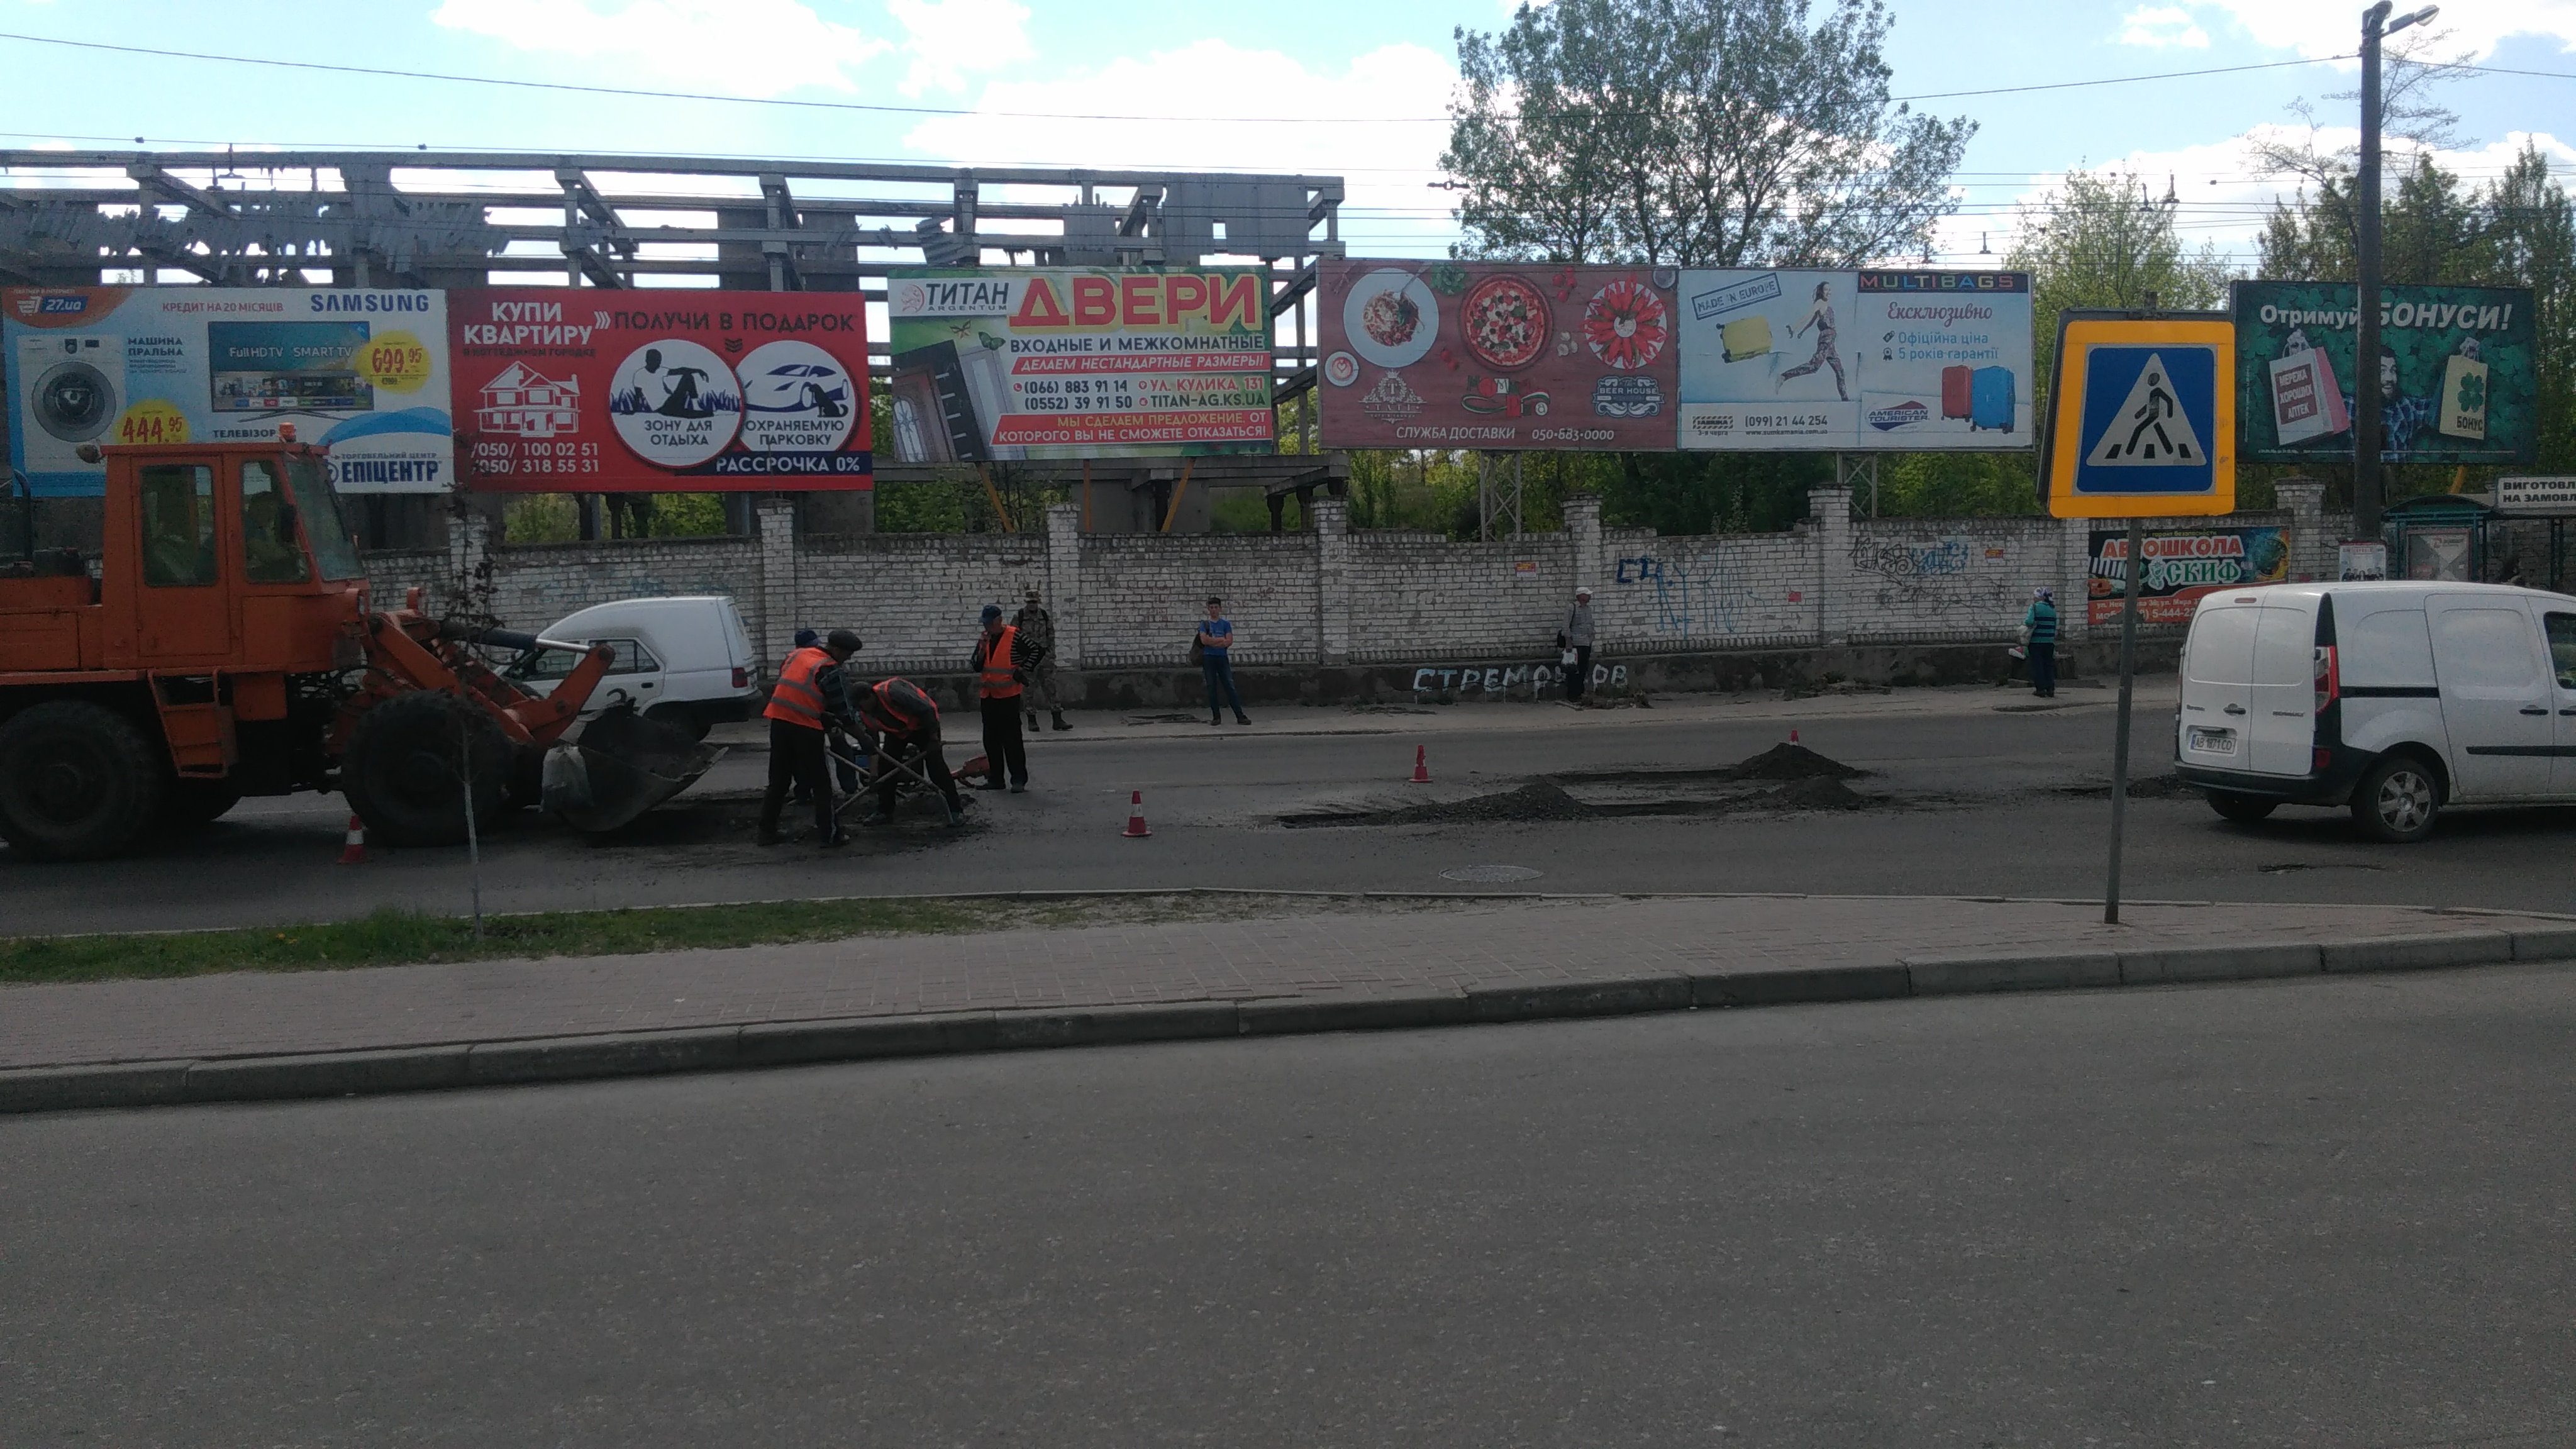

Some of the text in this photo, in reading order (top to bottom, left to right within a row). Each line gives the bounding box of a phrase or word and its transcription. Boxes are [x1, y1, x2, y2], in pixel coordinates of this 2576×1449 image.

[1860, 275, 2014, 288] MULTIBAGS
[926, 282, 1009, 306] ТИТАН
[1009, 276, 1257, 327] ДВЕРИ
[1697, 296, 1724, 313] MADE
[1739, 280, 1777, 300] EUROPE
[46, 299, 82, 311] 27.ua
[162, 303, 284, 313] КРЕДИТ НА 20 МІСЯЦІВ
[311, 294, 430, 313] SAMSUNG
[491, 302, 562, 322] КУПИ
[1887, 301, 1993, 328] Ексклюзивно
[2260, 304, 2359, 330] Отримуй
[614, 311, 855, 333] ПОЛУЧИ В ПОДАРОК
[128, 337, 183, 346] МАШИНА
[464, 325, 593, 345] КВАРТИРУ
[1898, 331, 1989, 345] Офіційна ціна
[128, 347, 184, 357] ПРАЛЬНА
[294, 347, 352, 357] SMART TV
[1010, 335, 1263, 354] ВХОДНЫЕ И МЕЖКОМНАТНЫЕ
[548, 348, 596, 357] ГОРОДКЕ
[1898, 347, 1999, 362] 5 років гарантії
[1021, 355, 1264, 372] ДЕЛАЕМ НЕСТАНДАРТНЫЕ РАЗМЕРЫ!
[1150, 377, 1263, 392] УЛ. КУЛИКА, 131
[2279, 369, 2308, 386] МЕРЕЖА
[1024, 379, 1128, 394] (066) 883 91 14
[2279, 384, 2313, 404] ХОРОШИХ
[1024, 396, 1133, 410] (0552) 39 91 50
[1150, 393, 1265, 408] TITAN-AG.KS.UA
[2288, 402, 2309, 419] АПТЕК
[644, 420, 713, 432] ЗОНУ ДЛЯ
[745, 419, 845, 431] ОХРАНЯЕМУЮ
[1057, 412, 1266, 428] МЫ СДЕЛАЕМ ПРЕДЛОЖЕНИЕ. ОТ
[1745, 414, 1828, 428] (099) 21 44 254
[2457, 415, 2484, 431] БОНУС
[213, 429, 277, 438] ТЕЛЕВІЗОР
[650, 434, 709, 447] ОТДЫХА
[759, 434, 832, 445] ПАРКОВКУ
[999, 426, 1267, 442] КОТОРОГО ВЫ НЕ СМОЖЕТЕ ОТКАЗАТЬСЯ!
[1396, 426, 1446, 438] СЛУЖБА
[1449, 426, 1516, 440] ДОСТАВКИ
[341, 451, 407, 460] ТОРГОВЕЛЬНИЙ
[522, 443, 551, 457] 100
[555, 442, 577, 456] 02
[580, 442, 599, 456] 51
[341, 460, 439, 484] ЕПІЦЕНТР
[521, 459, 552, 473] 318
[557, 459, 576, 473] 55
[580, 459, 599, 473] 31
[716, 457, 861, 472] РАССРОЧКА 0%
[2503, 494, 2521, 502] НА
[2102, 537, 2243, 558] АВОШКОЛА
[2167, 561, 2240, 583] СКИФ
